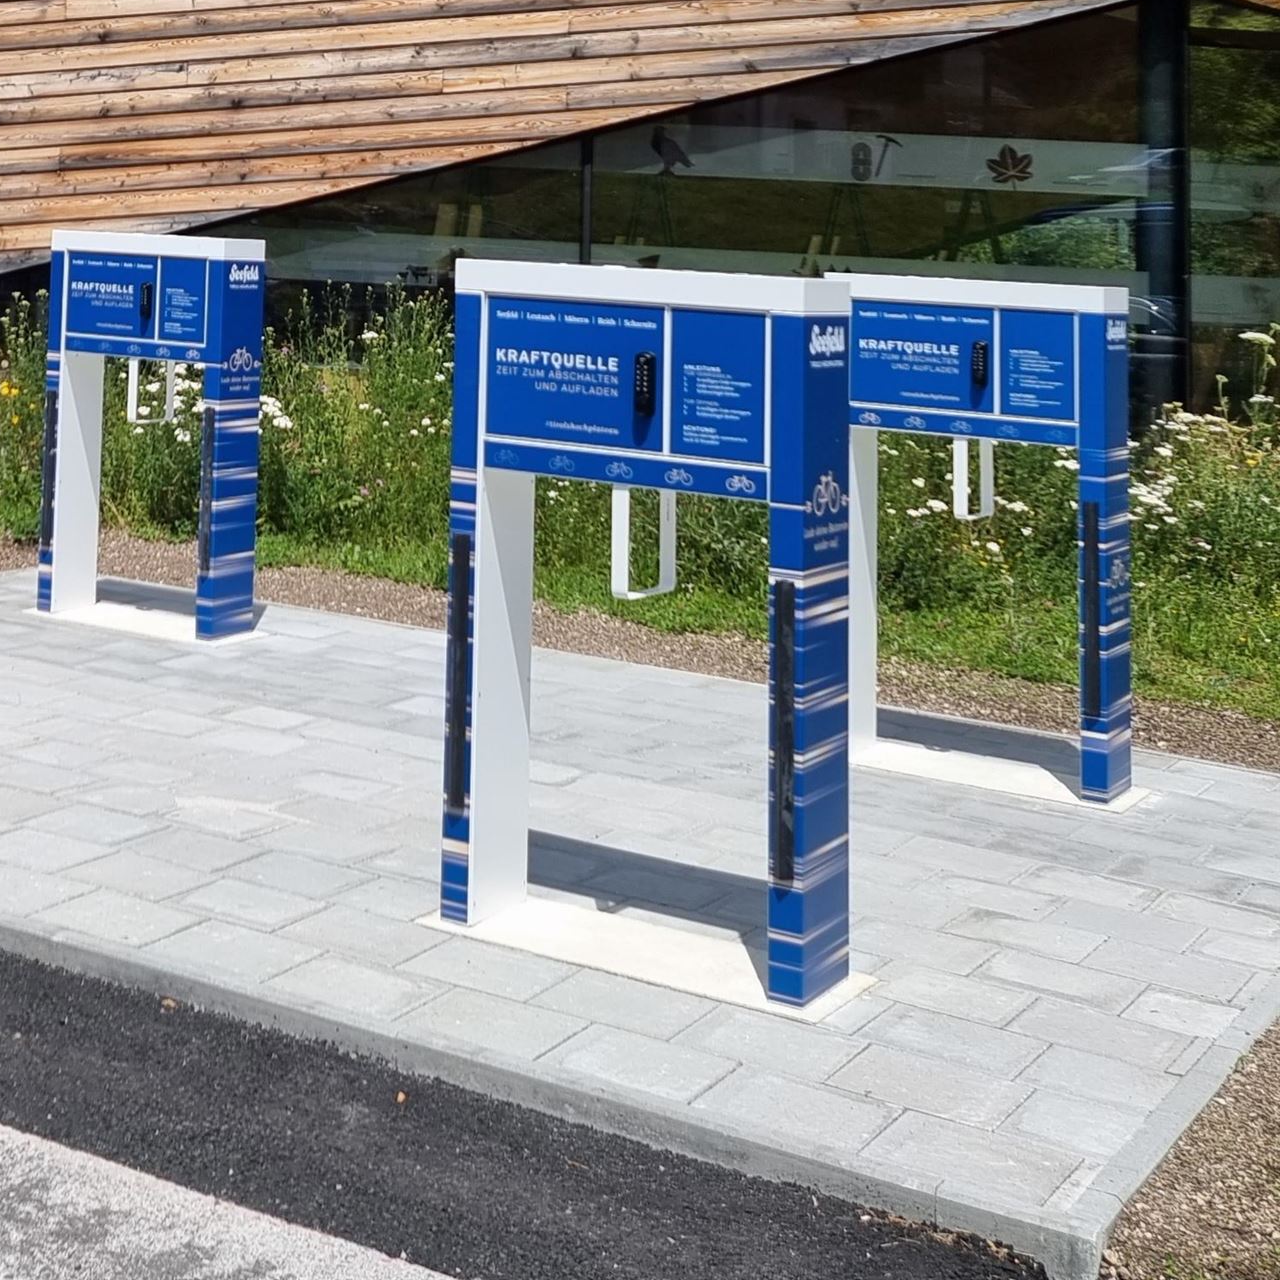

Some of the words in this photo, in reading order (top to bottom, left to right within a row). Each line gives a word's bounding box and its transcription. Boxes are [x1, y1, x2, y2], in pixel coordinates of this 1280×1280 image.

[71, 280, 134, 294] KRAFTQUELLE
[858, 338, 960, 356] KRAFTQUELLE
[496, 348, 619, 372] KRAFTQUELLE
[496, 365, 519, 376] ZEIT
[522, 367, 545, 378] ZUM
[548, 369, 619, 385] ABSCHALTEN
[535, 382, 558, 392] UND
[560, 383, 619, 398] AUFLADEN
